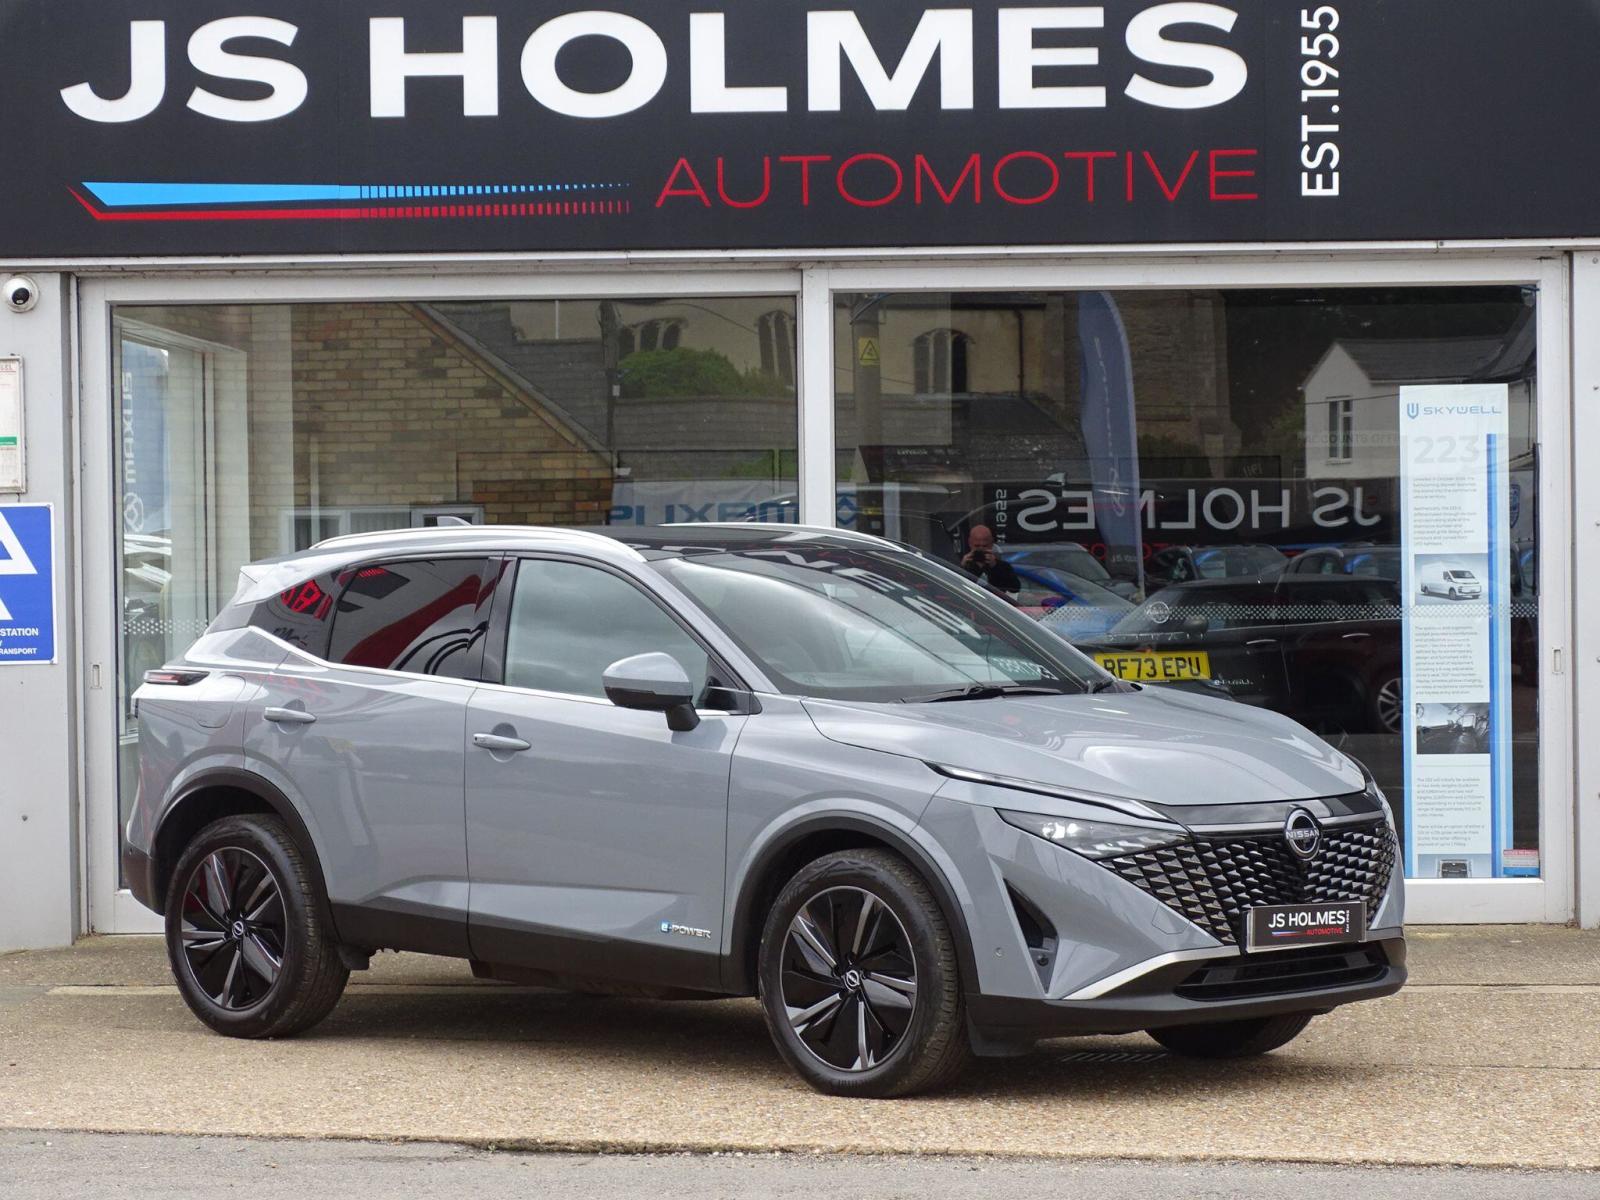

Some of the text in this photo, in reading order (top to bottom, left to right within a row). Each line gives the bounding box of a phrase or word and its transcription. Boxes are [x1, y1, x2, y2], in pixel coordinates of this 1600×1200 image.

[60, 1, 1248, 123] JS HOLMES
[1301, 6, 1340, 197] EST.1955
[656, 149, 1258, 208] AUTOMOTIVE
[1423, 405, 1503, 416] SKYWELL
[1413, 435, 1480, 464] 223
[0, 627, 39, 637] STATION
[1103, 656, 1202, 679] RF73 EPU
[1285, 830, 1320, 840] NISSAN
[1268, 913, 1286, 928] JS
[1288, 910, 1346, 926] HOLMES
[1305, 927, 1344, 936] AUTOMOTIVE
